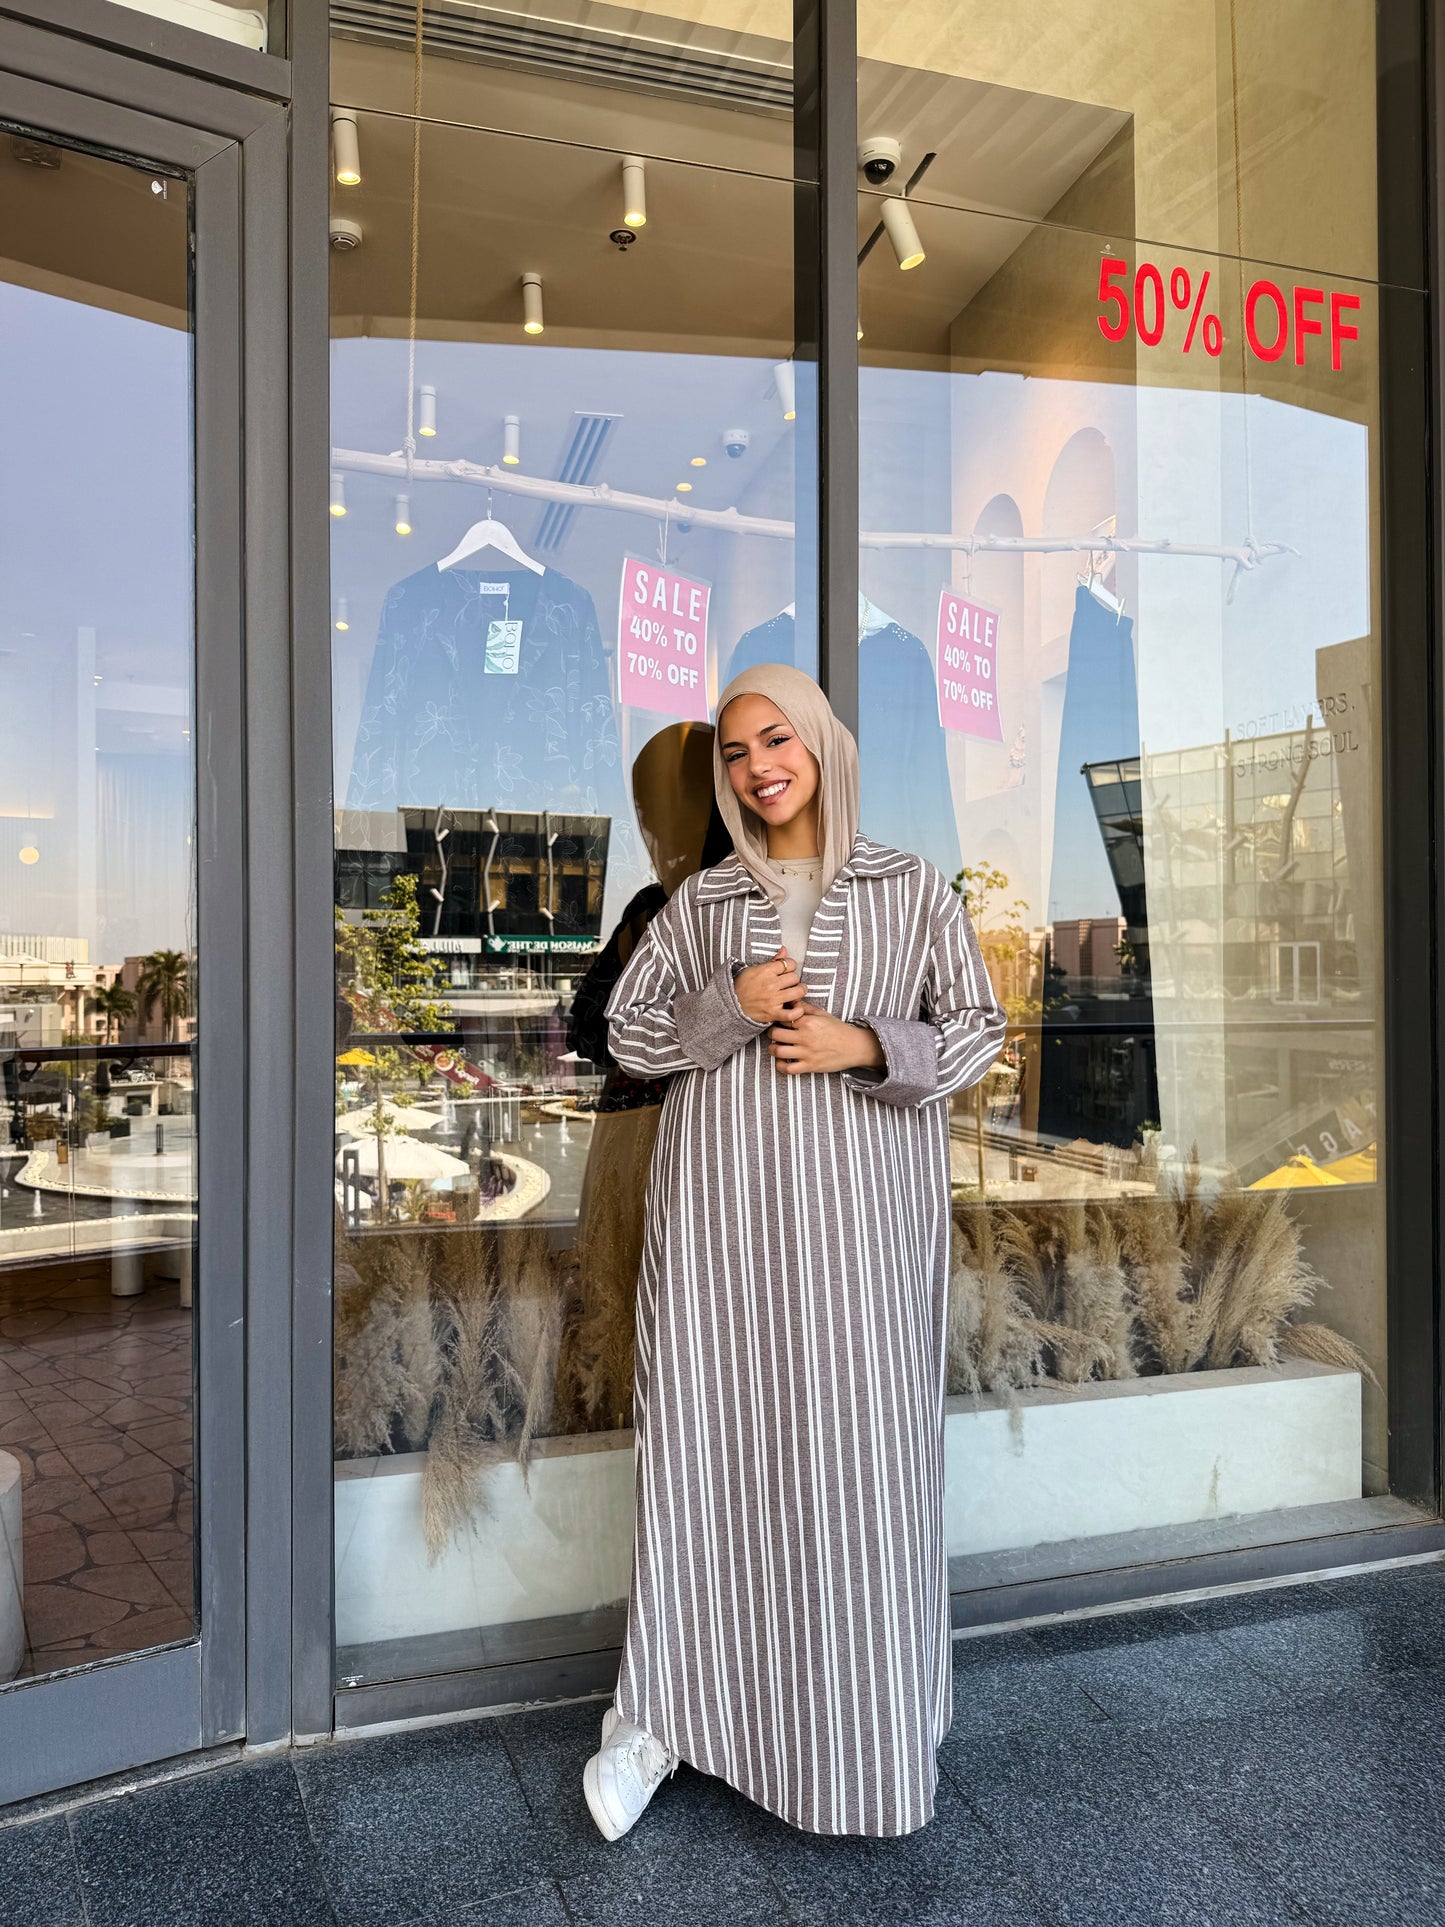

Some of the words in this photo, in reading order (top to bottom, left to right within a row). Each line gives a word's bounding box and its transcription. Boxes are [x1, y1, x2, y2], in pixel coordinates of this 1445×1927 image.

[1096, 256, 1223, 357] 50%
[1245, 279, 1361, 371] OFF
[634, 569, 702, 622] SALE
[629, 615, 668, 648] 40%
[673, 628, 697, 655] TO
[946, 601, 994, 648] SALE
[627, 652, 662, 681] 70%
[667, 663, 699, 689] OFF
[944, 644, 971, 673] 40%
[974, 654, 991, 679] TO
[943, 678, 969, 705] 70%
[971, 687, 993, 711] OFF
[1236, 712, 1279, 742] SOFT
[1236, 743, 1304, 778] STRONG
[1308, 730, 1359, 761] SOUL
